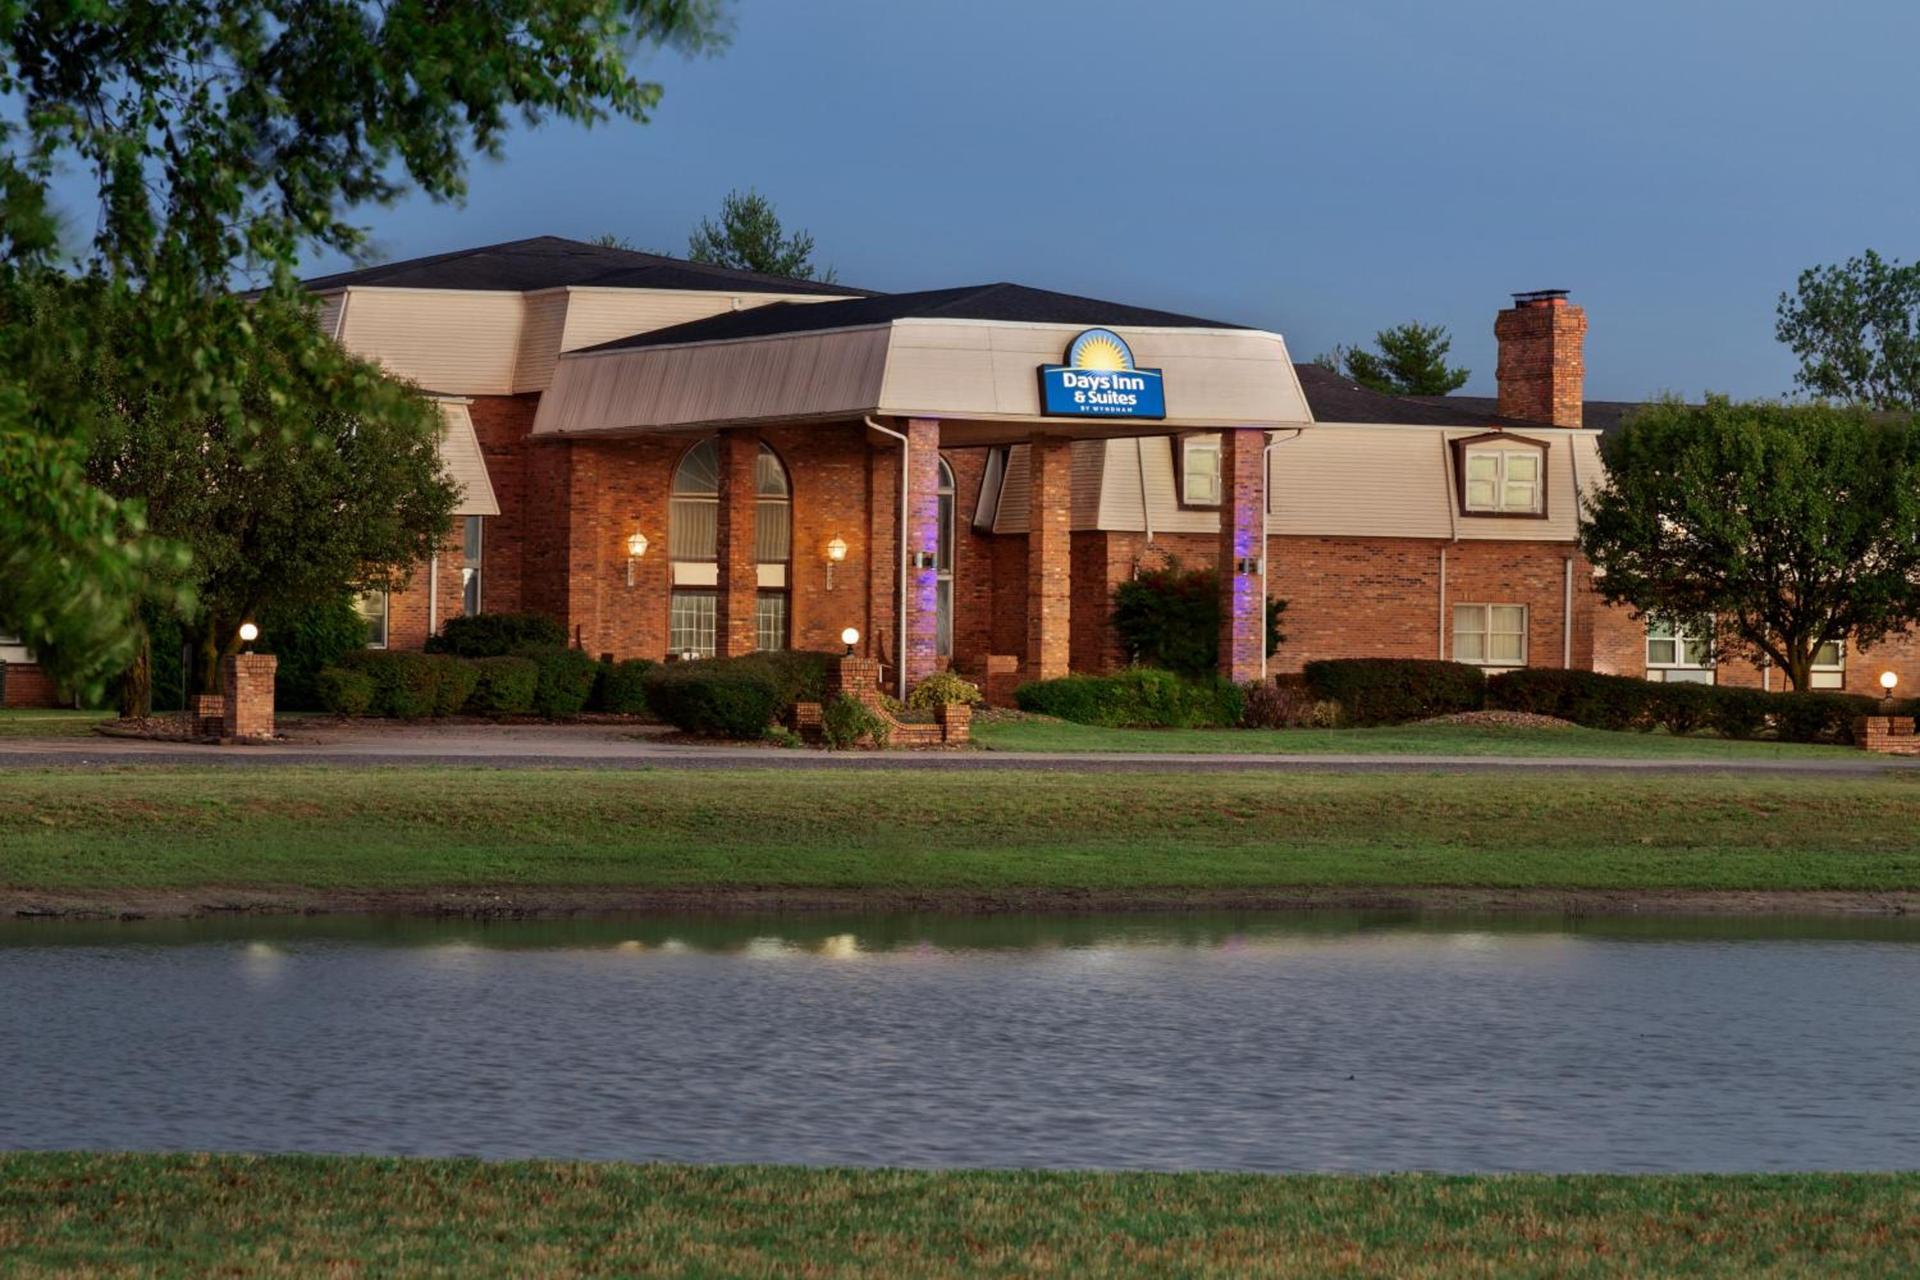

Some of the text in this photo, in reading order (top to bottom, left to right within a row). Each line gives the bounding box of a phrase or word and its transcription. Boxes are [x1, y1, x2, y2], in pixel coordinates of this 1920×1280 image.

[1063, 373, 1144, 391] Days Inn
[1074, 391, 1137, 405] & Suites
